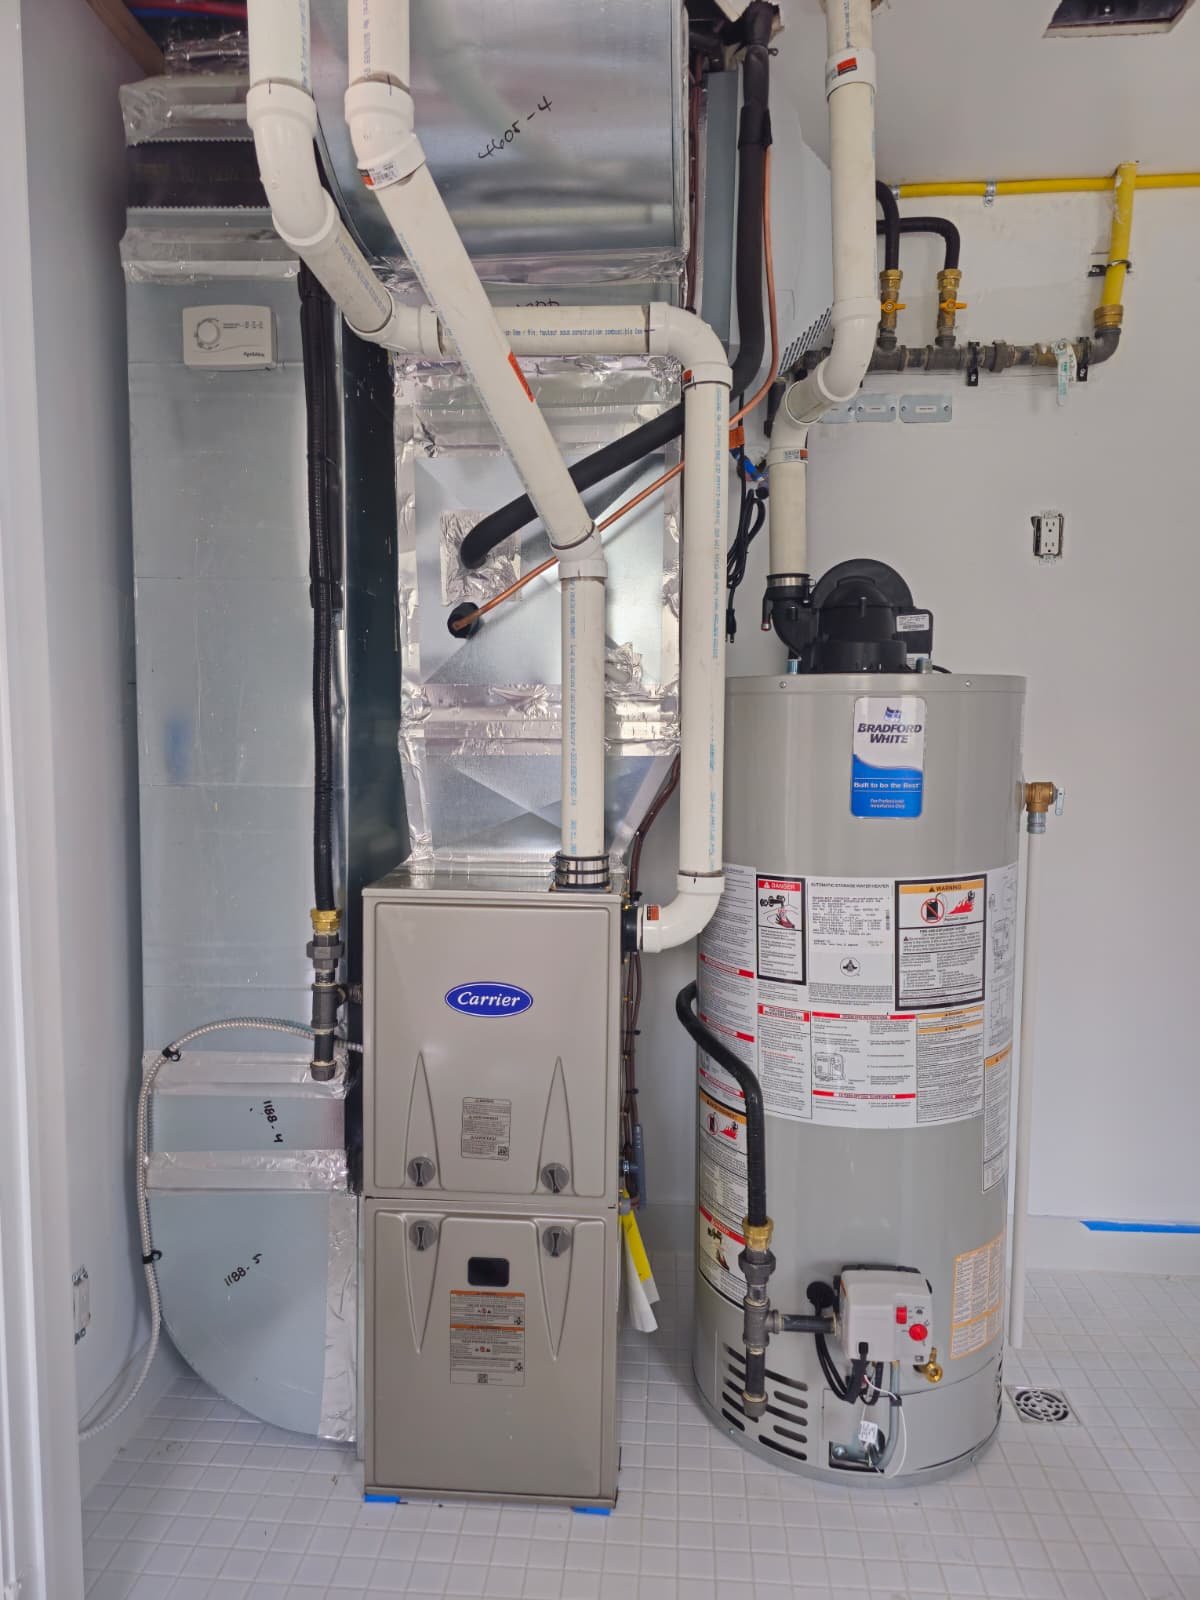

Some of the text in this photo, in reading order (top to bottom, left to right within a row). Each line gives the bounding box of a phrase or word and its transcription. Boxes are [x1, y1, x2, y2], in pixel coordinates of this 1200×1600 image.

[857, 722, 923, 733] BRADFORD
[869, 734, 909, 744] WHITE
[936, 884, 962, 892] WARNING
[457, 991, 521, 1007] Carrier
